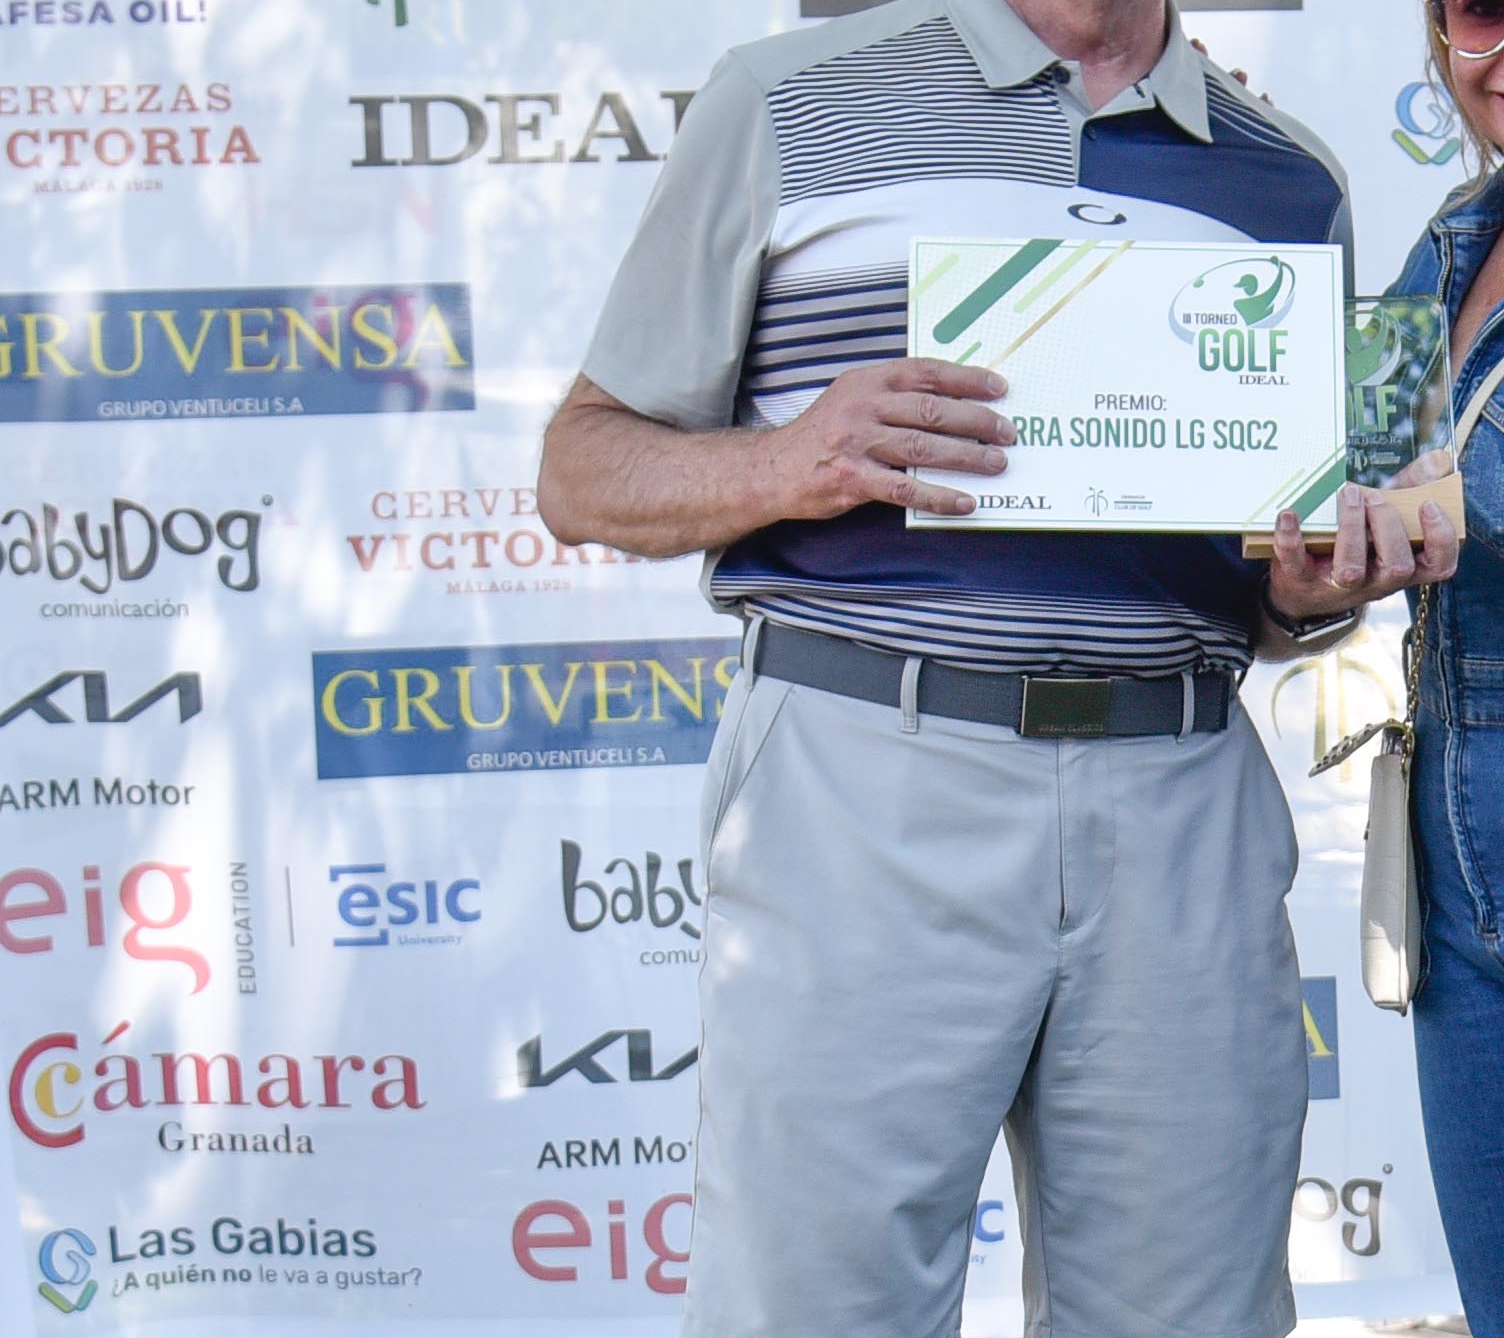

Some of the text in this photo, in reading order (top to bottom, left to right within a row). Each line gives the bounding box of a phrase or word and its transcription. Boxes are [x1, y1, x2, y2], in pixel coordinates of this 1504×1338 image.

[1194, 313, 1238, 325] TORNEO
[1198, 328, 1288, 372] GOLF
[1238, 375, 1290, 386] IDEAL
[99, 397, 270, 418] GRUPO VENTUCELI
[1094, 393, 1167, 411] PREMIO:
[1070, 417, 1166, 448] SONIDO
[1175, 419, 1205, 449] LG
[1212, 420, 1278, 452] SQC2
[371, 488, 537, 519] CERVE
[978, 495, 1051, 510] IDEAL
[40, 597, 190, 619] comunicación
[321, 656, 742, 736] GRUVENS
[467, 749, 632, 771] GRUPO VENTUCELI
[94, 776, 195, 807] Motor
[230, 861, 258, 995] EDUCATION
[396, 932, 464, 947] University
[157, 1122, 315, 1157] Granada
[537, 1137, 621, 1170] ARM
[109, 1216, 377, 1263] Las Gabias
[111, 1263, 422, 1298] ¿A quién no le va a gustar?
